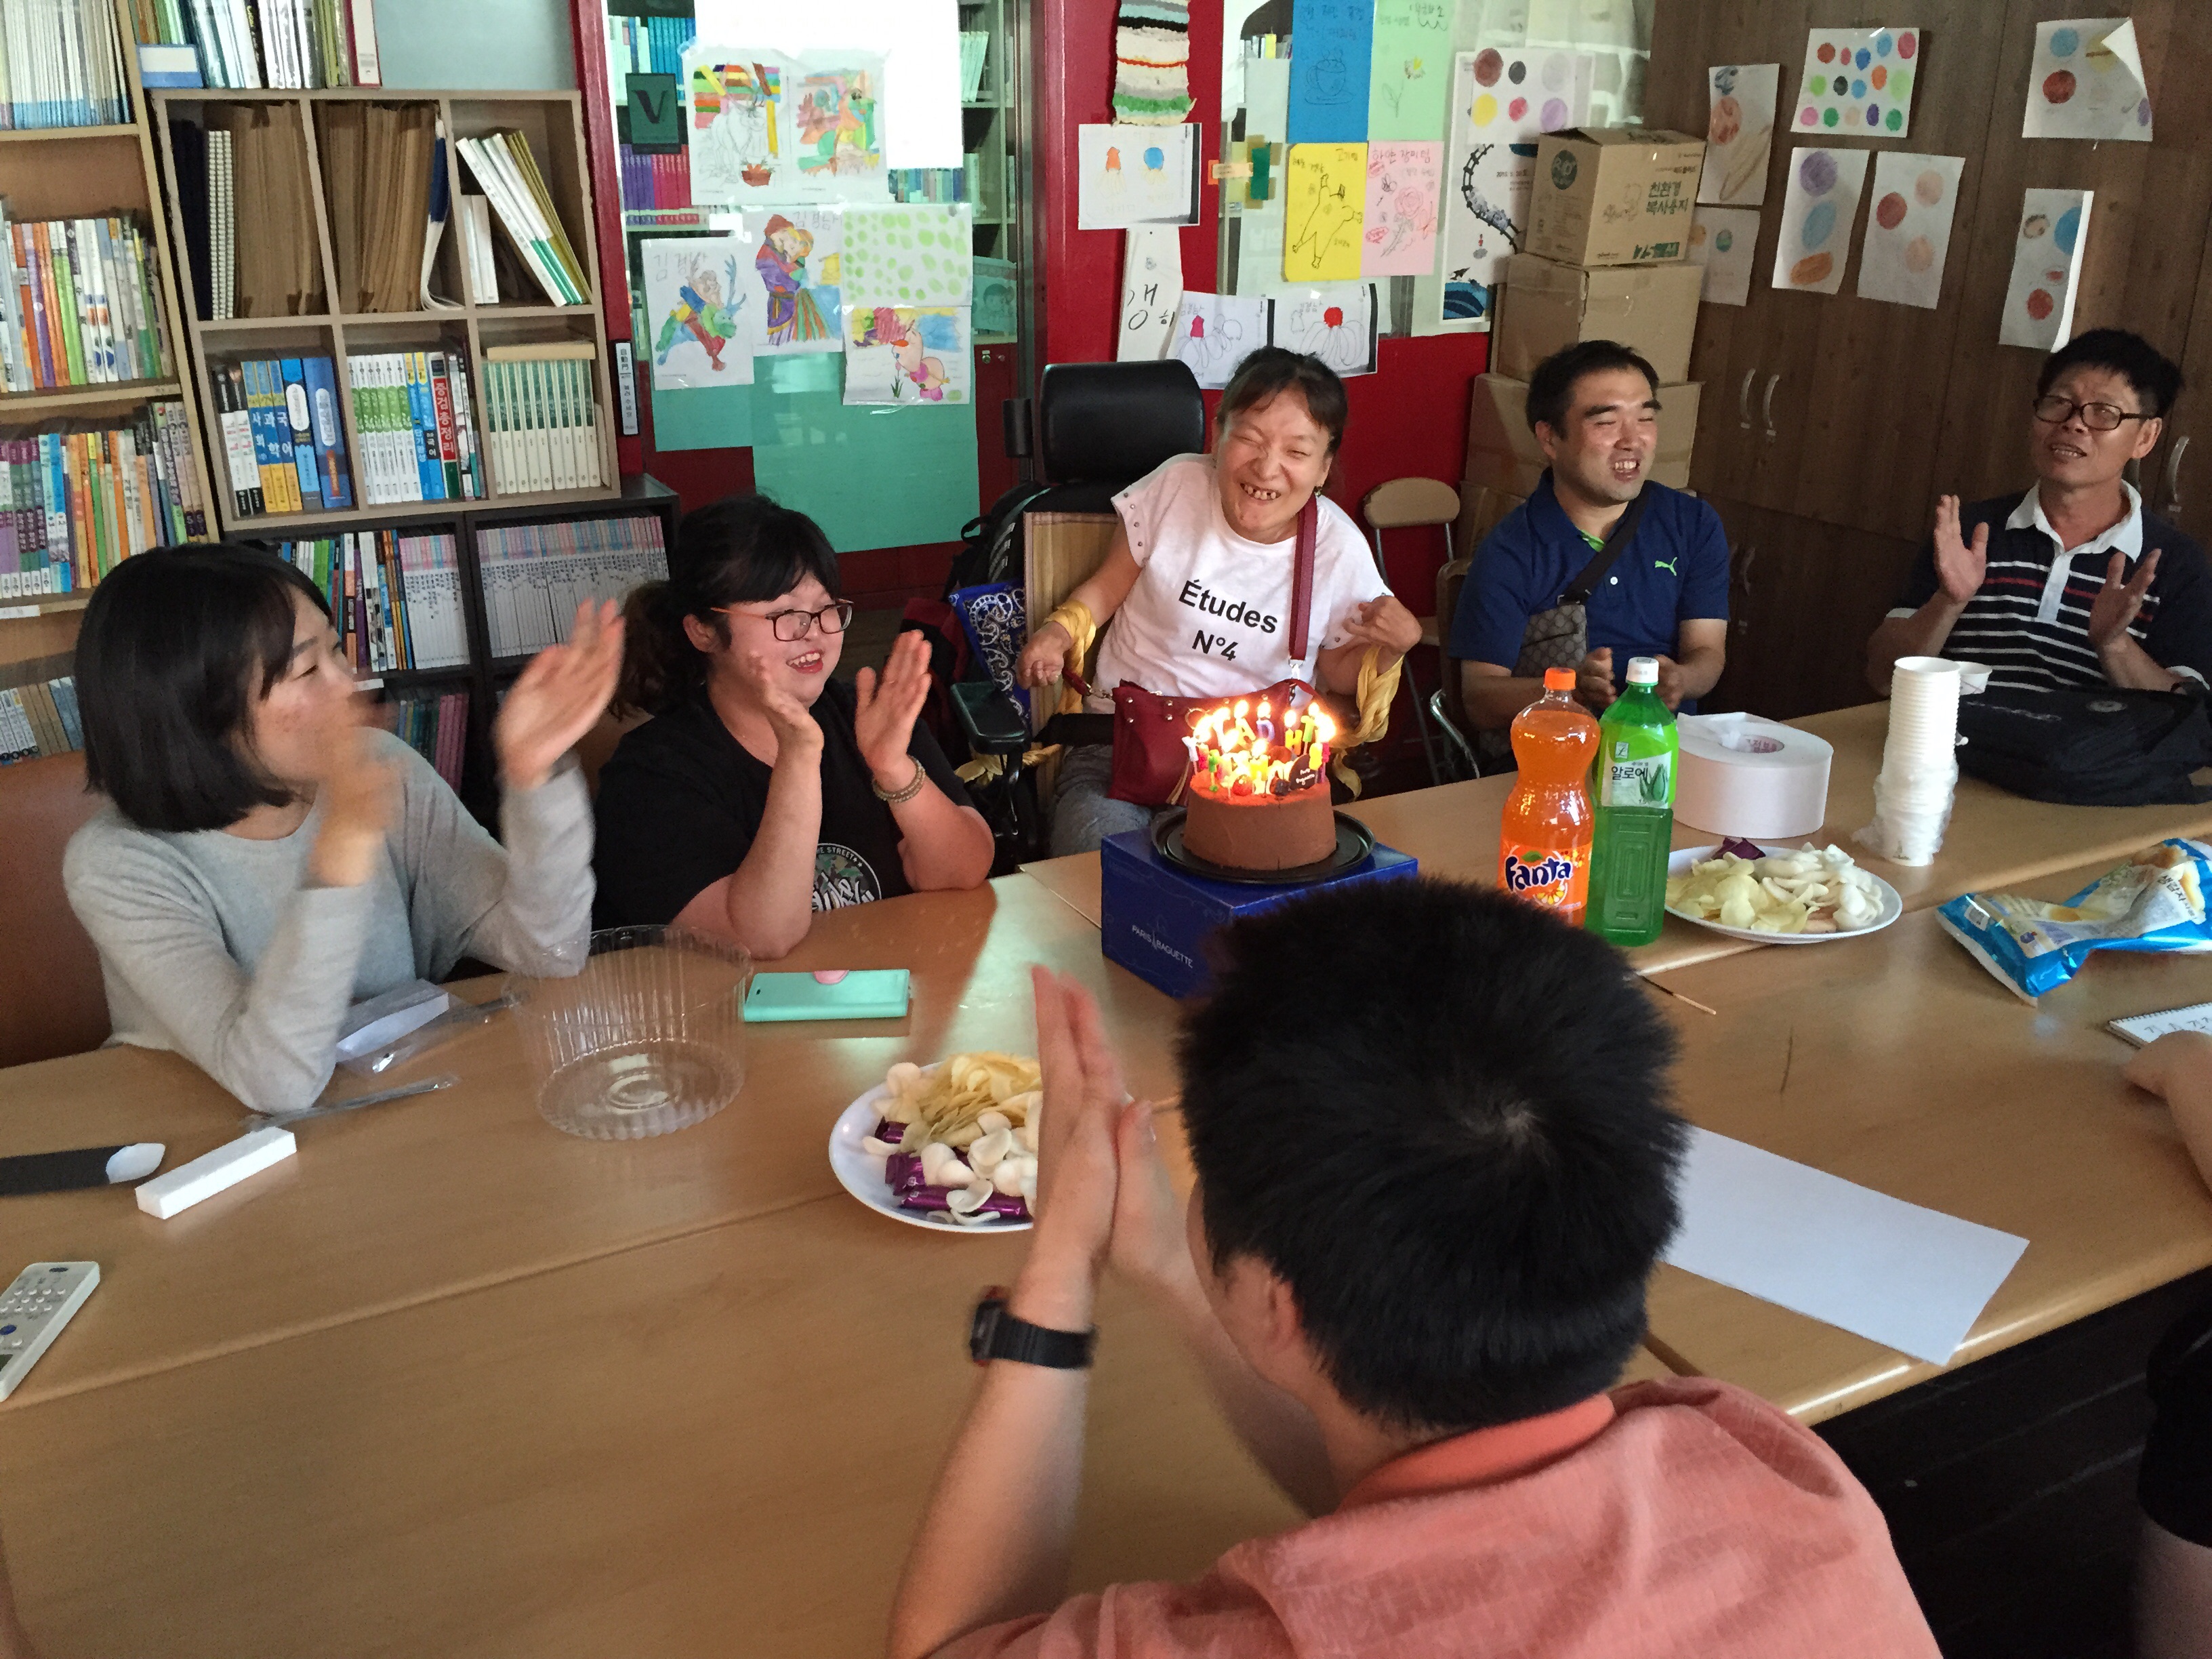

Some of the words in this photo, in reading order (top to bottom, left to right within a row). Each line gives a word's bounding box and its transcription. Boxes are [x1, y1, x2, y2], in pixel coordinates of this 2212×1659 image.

[1648, 180, 1682, 198] 친환경
[1646, 197, 1689, 216] 복사용지
[1178, 578, 1278, 634] Études
[1191, 629, 1239, 661] N°4
[1611, 765, 1649, 781] 알로에
[1131, 924, 1152, 943] PARIS
[1155, 939, 1193, 969] BAGUETTE
